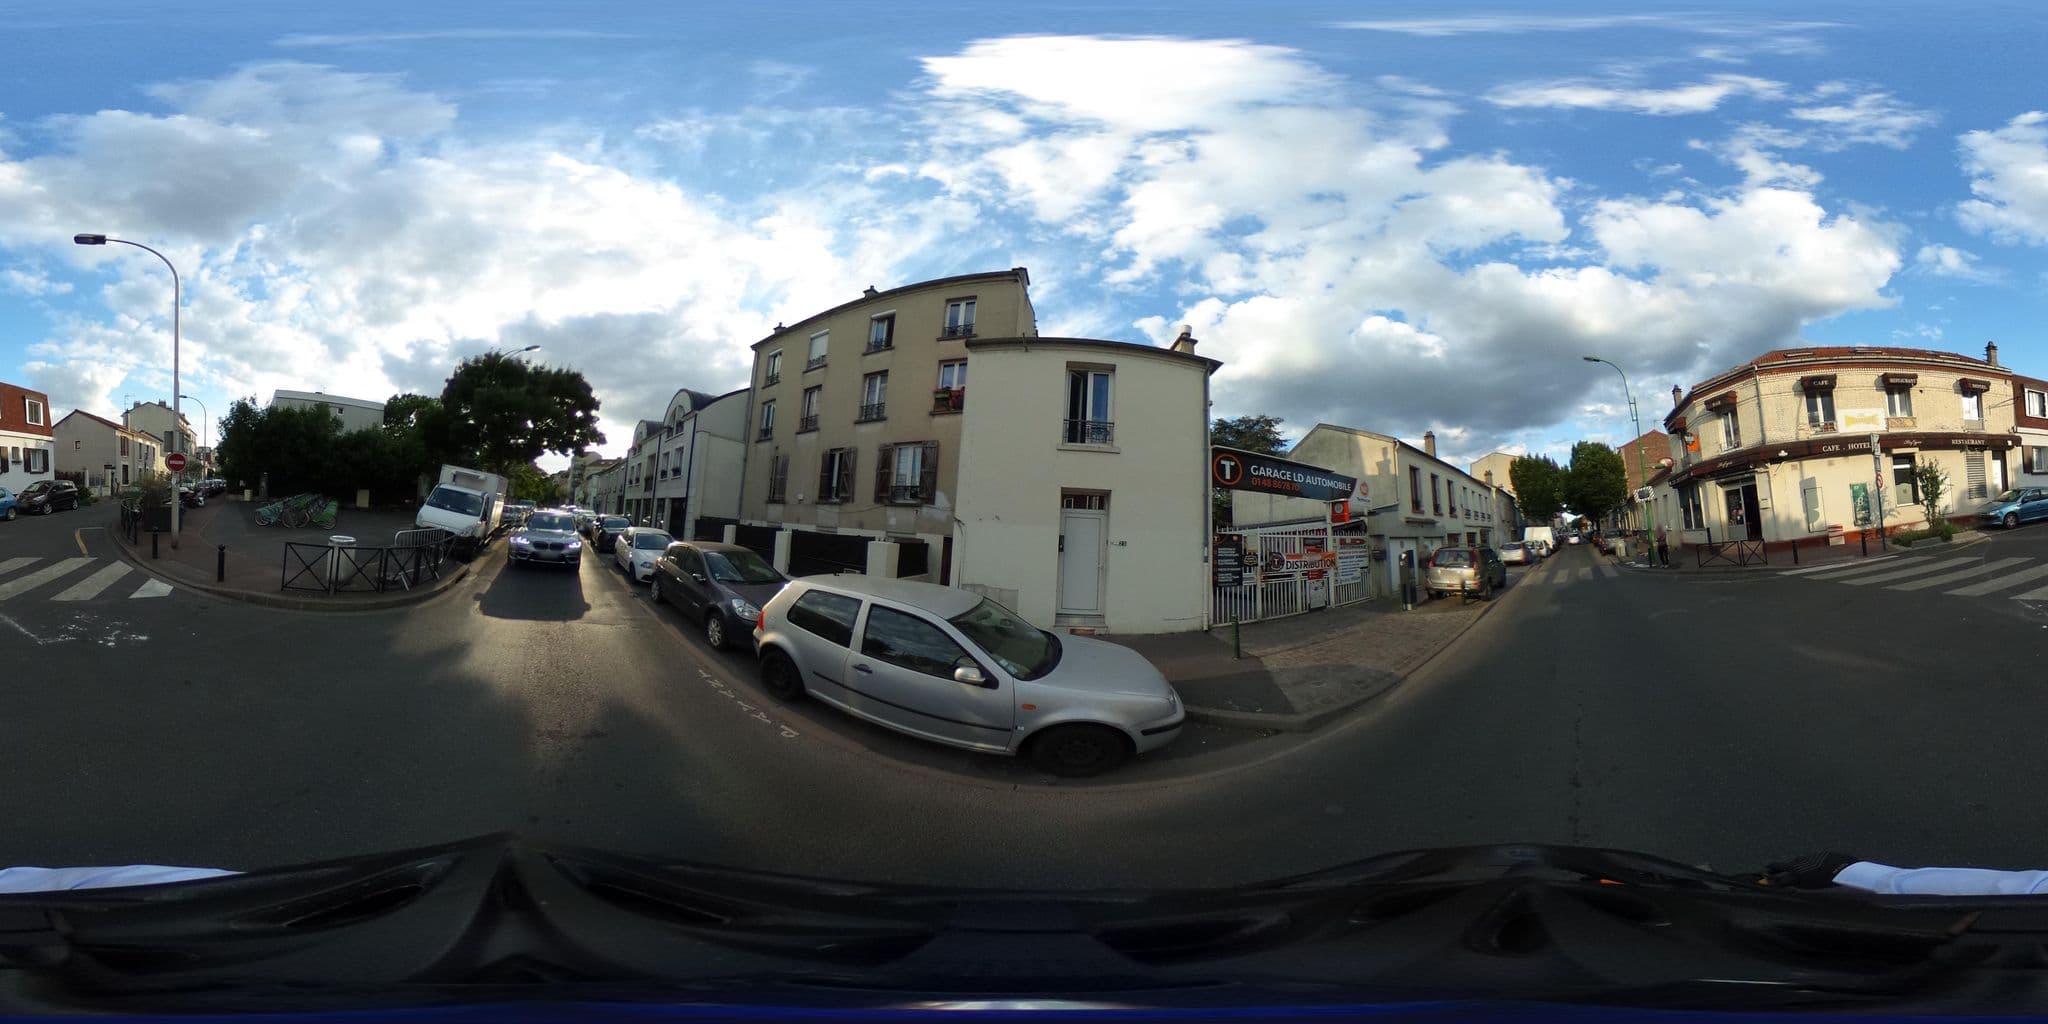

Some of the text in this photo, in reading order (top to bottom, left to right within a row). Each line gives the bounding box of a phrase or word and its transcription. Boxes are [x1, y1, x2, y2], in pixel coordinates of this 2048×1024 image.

[1822, 442, 1872, 452] CAFE HOTEL
[1250, 465, 1352, 491] GARAGE LD AUTOMOBILE
[1285, 558, 1336, 570] DISTRIBUTION
